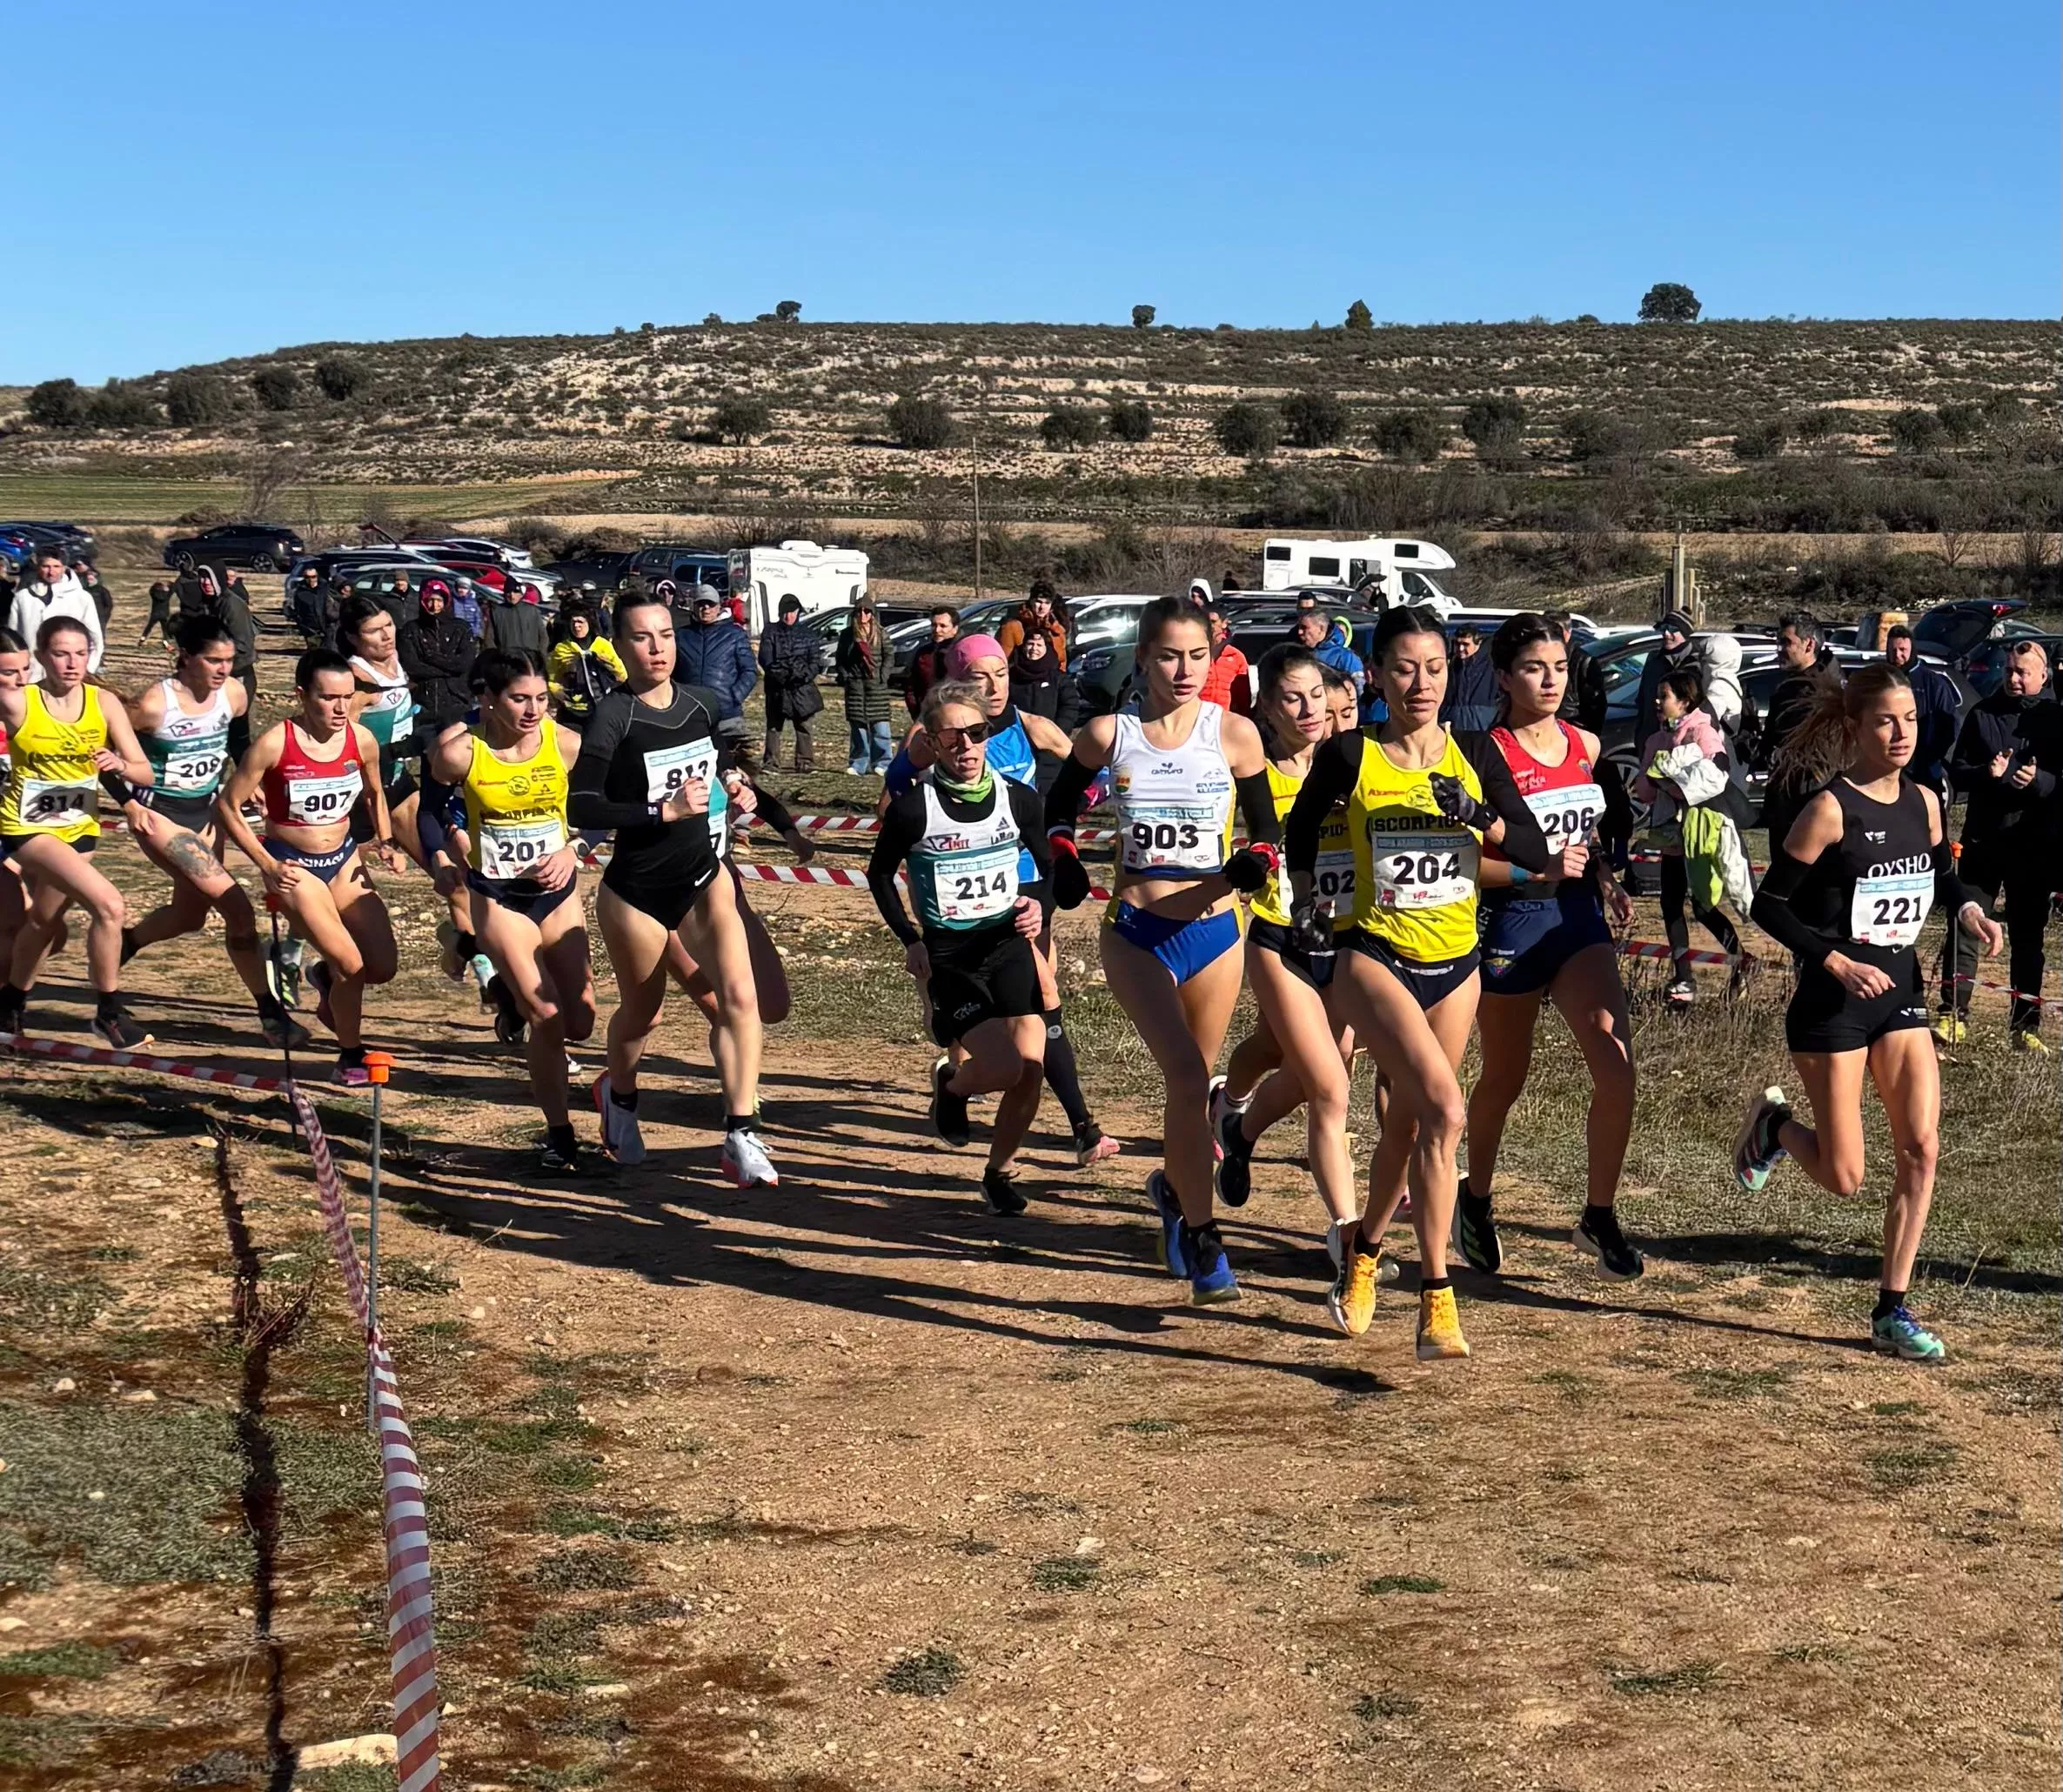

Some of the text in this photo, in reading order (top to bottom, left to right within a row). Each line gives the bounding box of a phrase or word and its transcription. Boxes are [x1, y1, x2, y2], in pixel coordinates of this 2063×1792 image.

[38, 793, 84, 812] 814
[304, 790, 352, 812] 907
[1544, 807, 1594, 836] 206
[1132, 822, 1199, 850] 903
[1392, 852, 1461, 885] 204
[1867, 853, 1932, 878] OYSHO
[955, 871, 1007, 900] 214
[1873, 896, 1921, 926] 221
